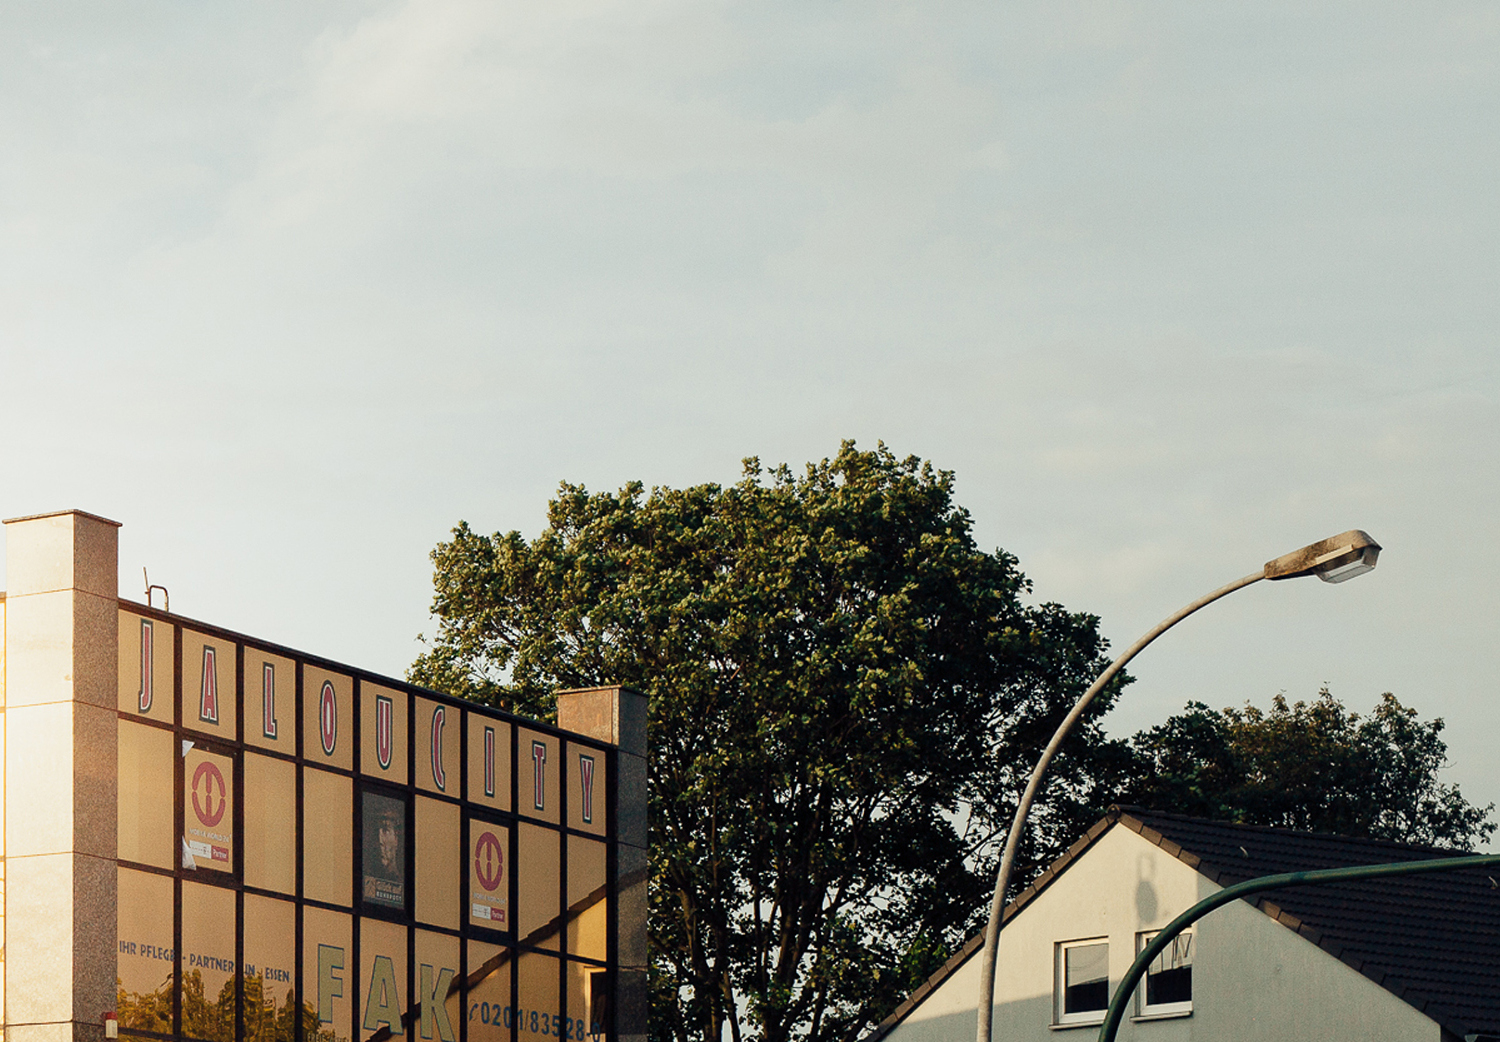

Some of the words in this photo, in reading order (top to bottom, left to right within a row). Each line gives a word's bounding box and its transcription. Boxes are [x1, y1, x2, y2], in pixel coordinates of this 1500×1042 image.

[119, 940, 136, 955] IHR
[189, 952, 235, 973] PARTNER
[265, 967, 291, 983] ESSEN
